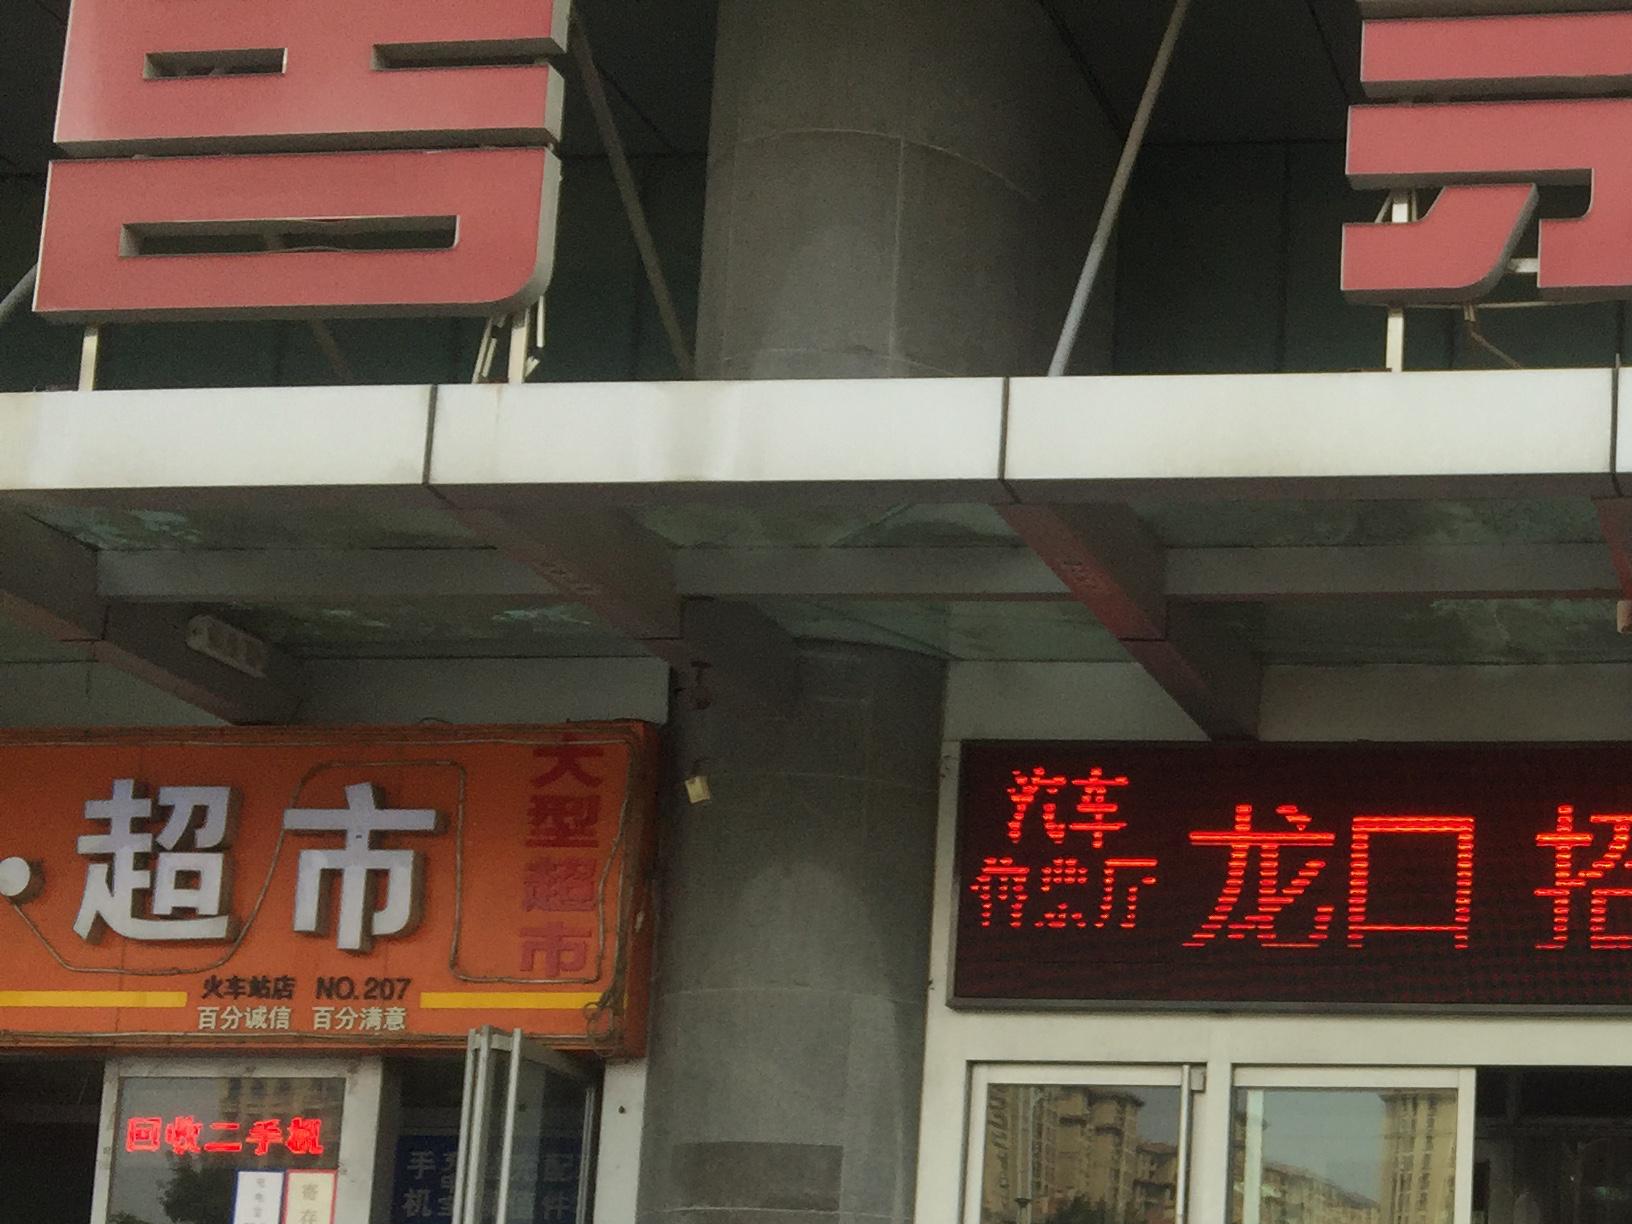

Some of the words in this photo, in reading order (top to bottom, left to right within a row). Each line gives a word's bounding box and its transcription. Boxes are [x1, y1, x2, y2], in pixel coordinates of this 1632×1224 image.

[1005, 766, 1130, 849] 汽车
[72, 778, 442, 954] 超市
[1182, 803, 1475, 949] 龙口
[196, 1004, 293, 1031] 百分诚信
[311, 1005, 406, 1031] 百分满意
[201, 974, 297, 1000] 火车站店
[125, 1114, 325, 1157] 回收二手机
